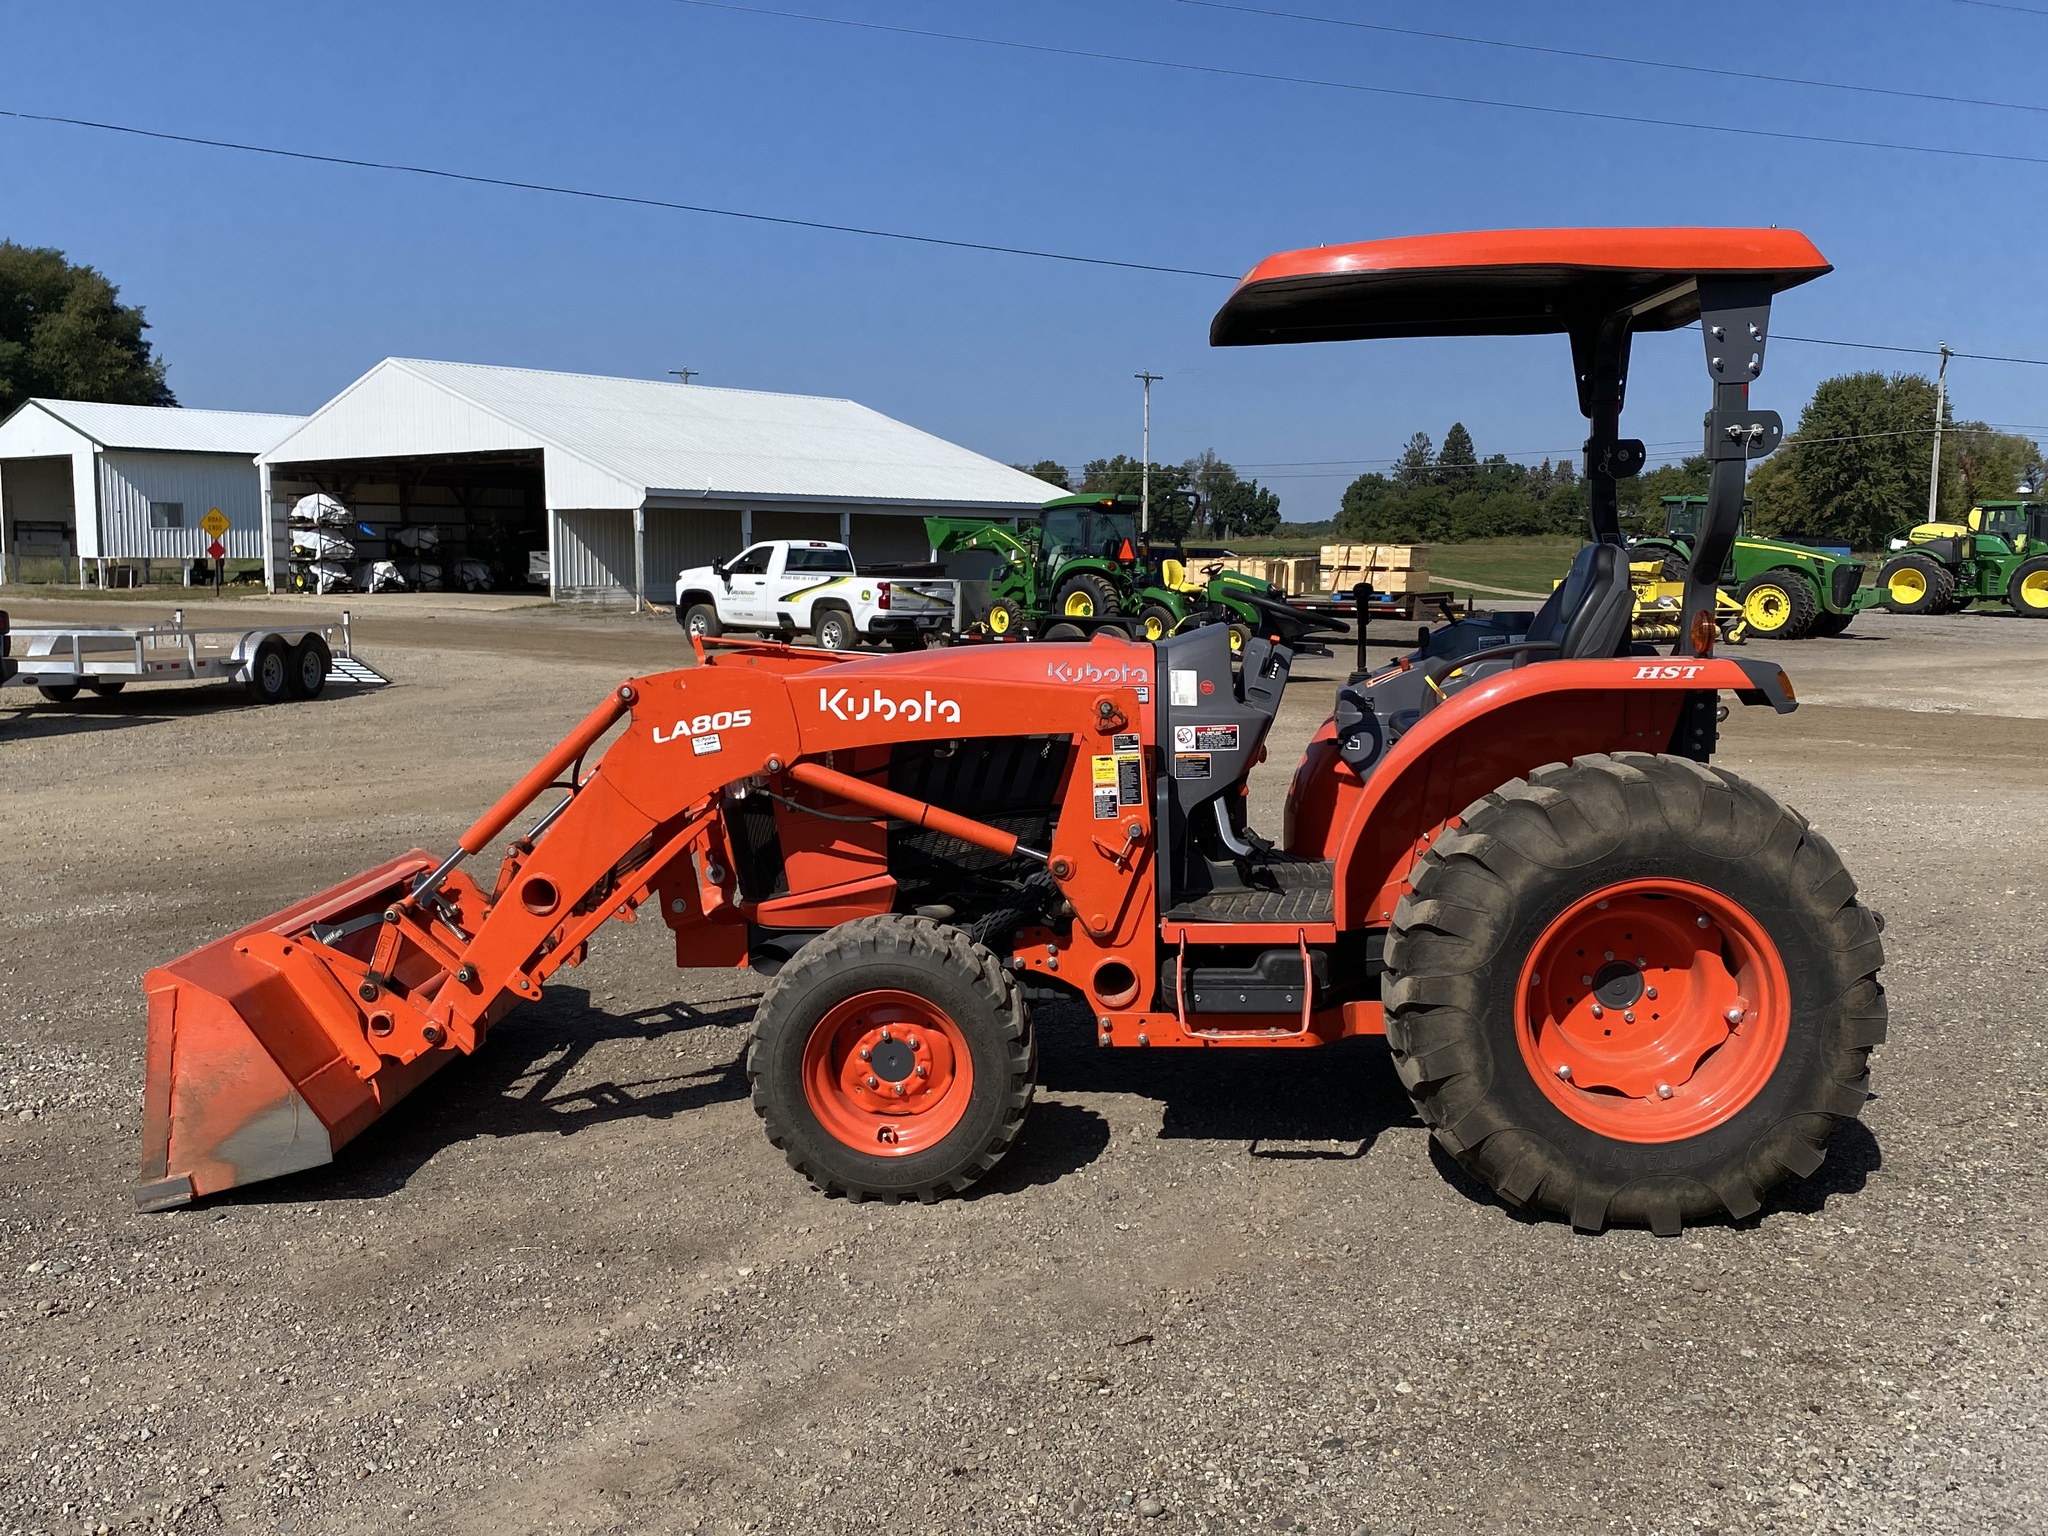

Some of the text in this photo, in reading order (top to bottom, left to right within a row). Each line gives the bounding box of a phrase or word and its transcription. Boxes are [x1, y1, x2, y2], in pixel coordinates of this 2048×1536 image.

[1047, 662, 1148, 682] Kubota
[1632, 665, 1704, 679] HST
[819, 687, 961, 723] Kubota
[652, 709, 752, 744] LA805
